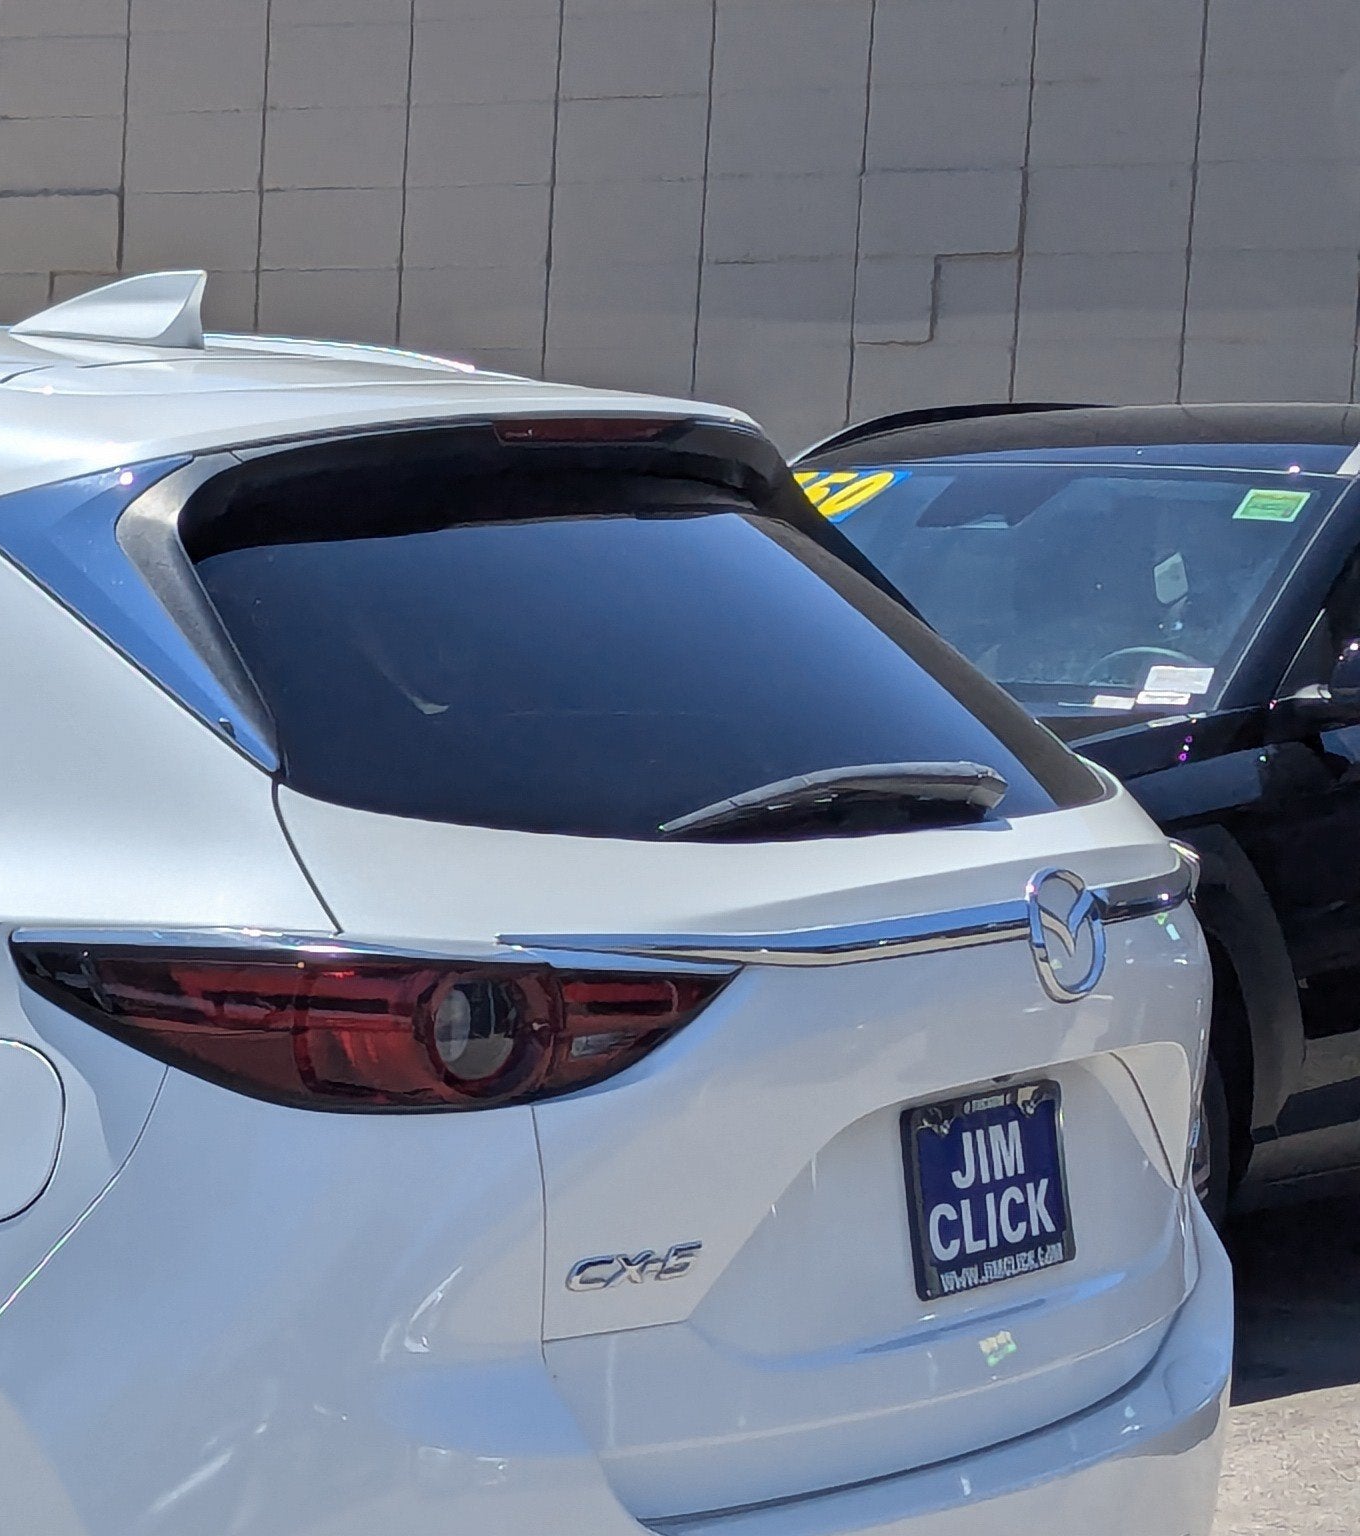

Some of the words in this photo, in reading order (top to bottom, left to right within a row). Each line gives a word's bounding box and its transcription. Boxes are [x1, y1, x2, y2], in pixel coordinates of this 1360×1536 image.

[951, 1120, 1025, 1189] JIM
[930, 1178, 1056, 1261] CLICK
[565, 1240, 702, 1292] CX-5
